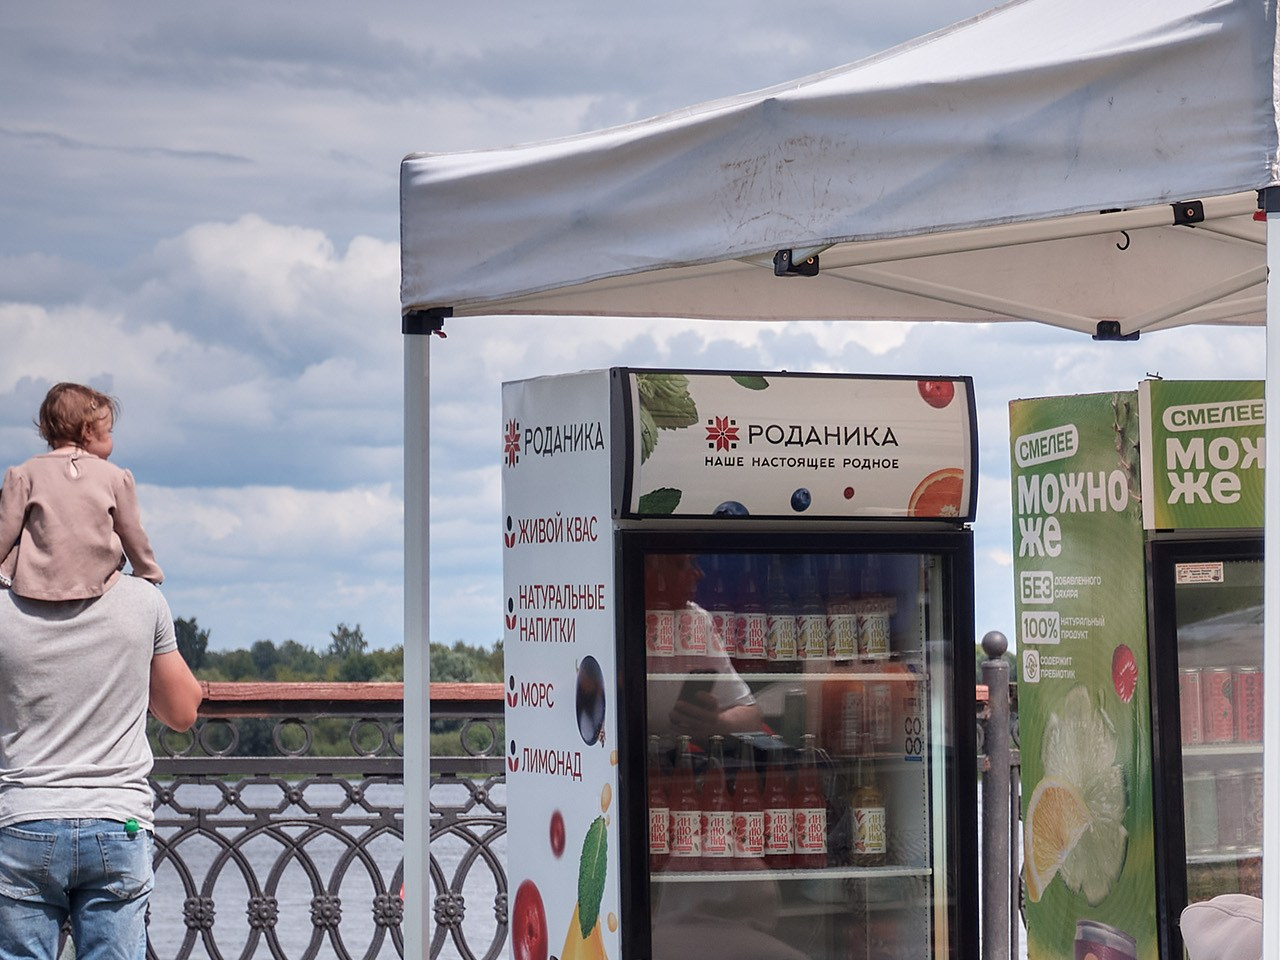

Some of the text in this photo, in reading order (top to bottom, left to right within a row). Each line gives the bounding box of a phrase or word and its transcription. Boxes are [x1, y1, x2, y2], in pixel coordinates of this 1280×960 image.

[524, 422, 605, 457] РОДАНИКА
[748, 425, 899, 447] РОДАНИКА
[1019, 430, 1074, 461] СМЕЛЕЕ
[705, 456, 899, 470] НАШЕ НАСТОЯЩЕЕ РОДНОЕ
[518, 513, 598, 544] ЖИВОЙ КВАС
[1023, 577, 1052, 599] БЕЗ
[1055, 577, 1101, 585] ДОБАВЛЕННОГО
[519, 584, 605, 611] НАТУРАЛЬНЫЕ
[1055, 590, 1078, 598] САХАРА
[520, 617, 576, 643] НАПИТКИ
[1024, 618, 1057, 638] 100%
[1061, 616, 1105, 626] НАТУРАЛЬНЫЙ
[1061, 631, 1088, 639] ПРОДУКТ
[1040, 657, 1072, 665] СОДЕРЖИТ
[1041, 670, 1075, 678] ПРЕБИОТИК
[521, 682, 554, 708] МОРС
[521, 748, 582, 781] ЛИМОНАД
